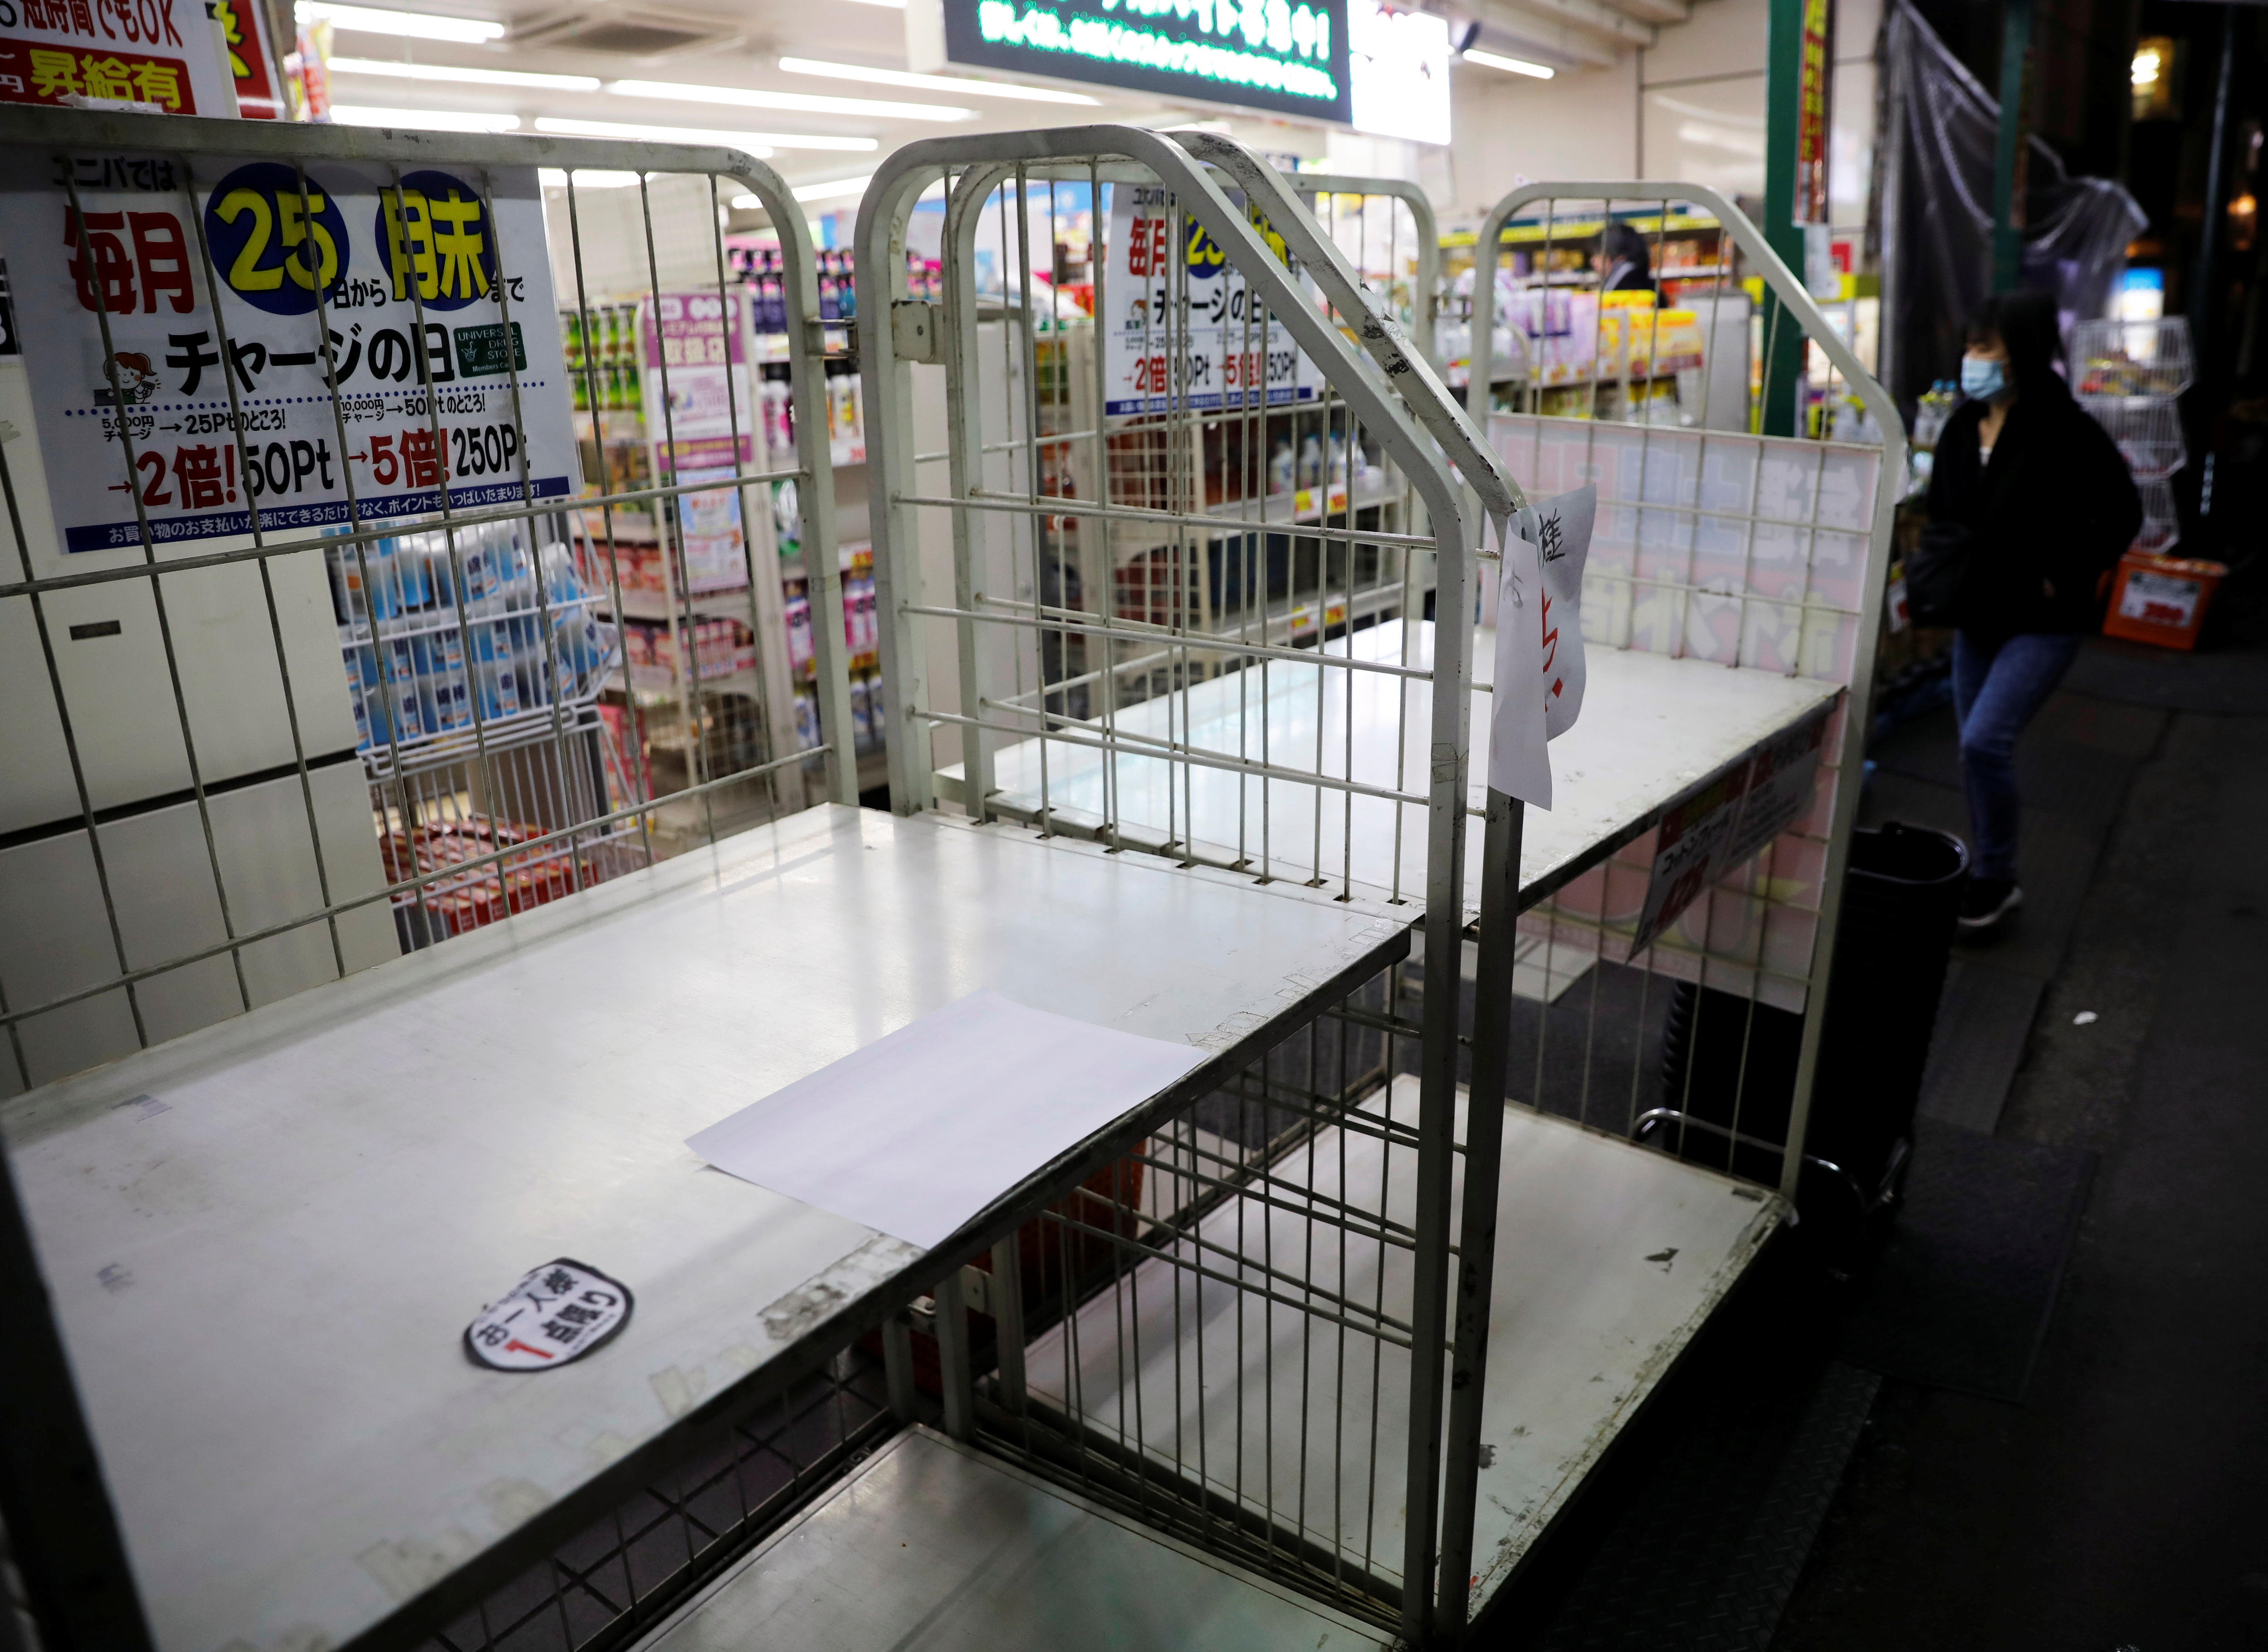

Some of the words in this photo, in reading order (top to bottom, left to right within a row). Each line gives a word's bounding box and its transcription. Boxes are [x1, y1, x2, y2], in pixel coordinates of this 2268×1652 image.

[29, 49, 181, 109] 昇給有
[51, 156, 177, 191] ユニバでは
[458, 327, 518, 341] UNIVERSL
[166, 322, 455, 396] チャージの日
[488, 348, 520, 360] STOE
[472, 364, 499, 372] Members
[341, 399, 384, 412] 10,000円
[342, 410, 385, 424] チャージ
[475, 1267, 580, 1347] お一人様
